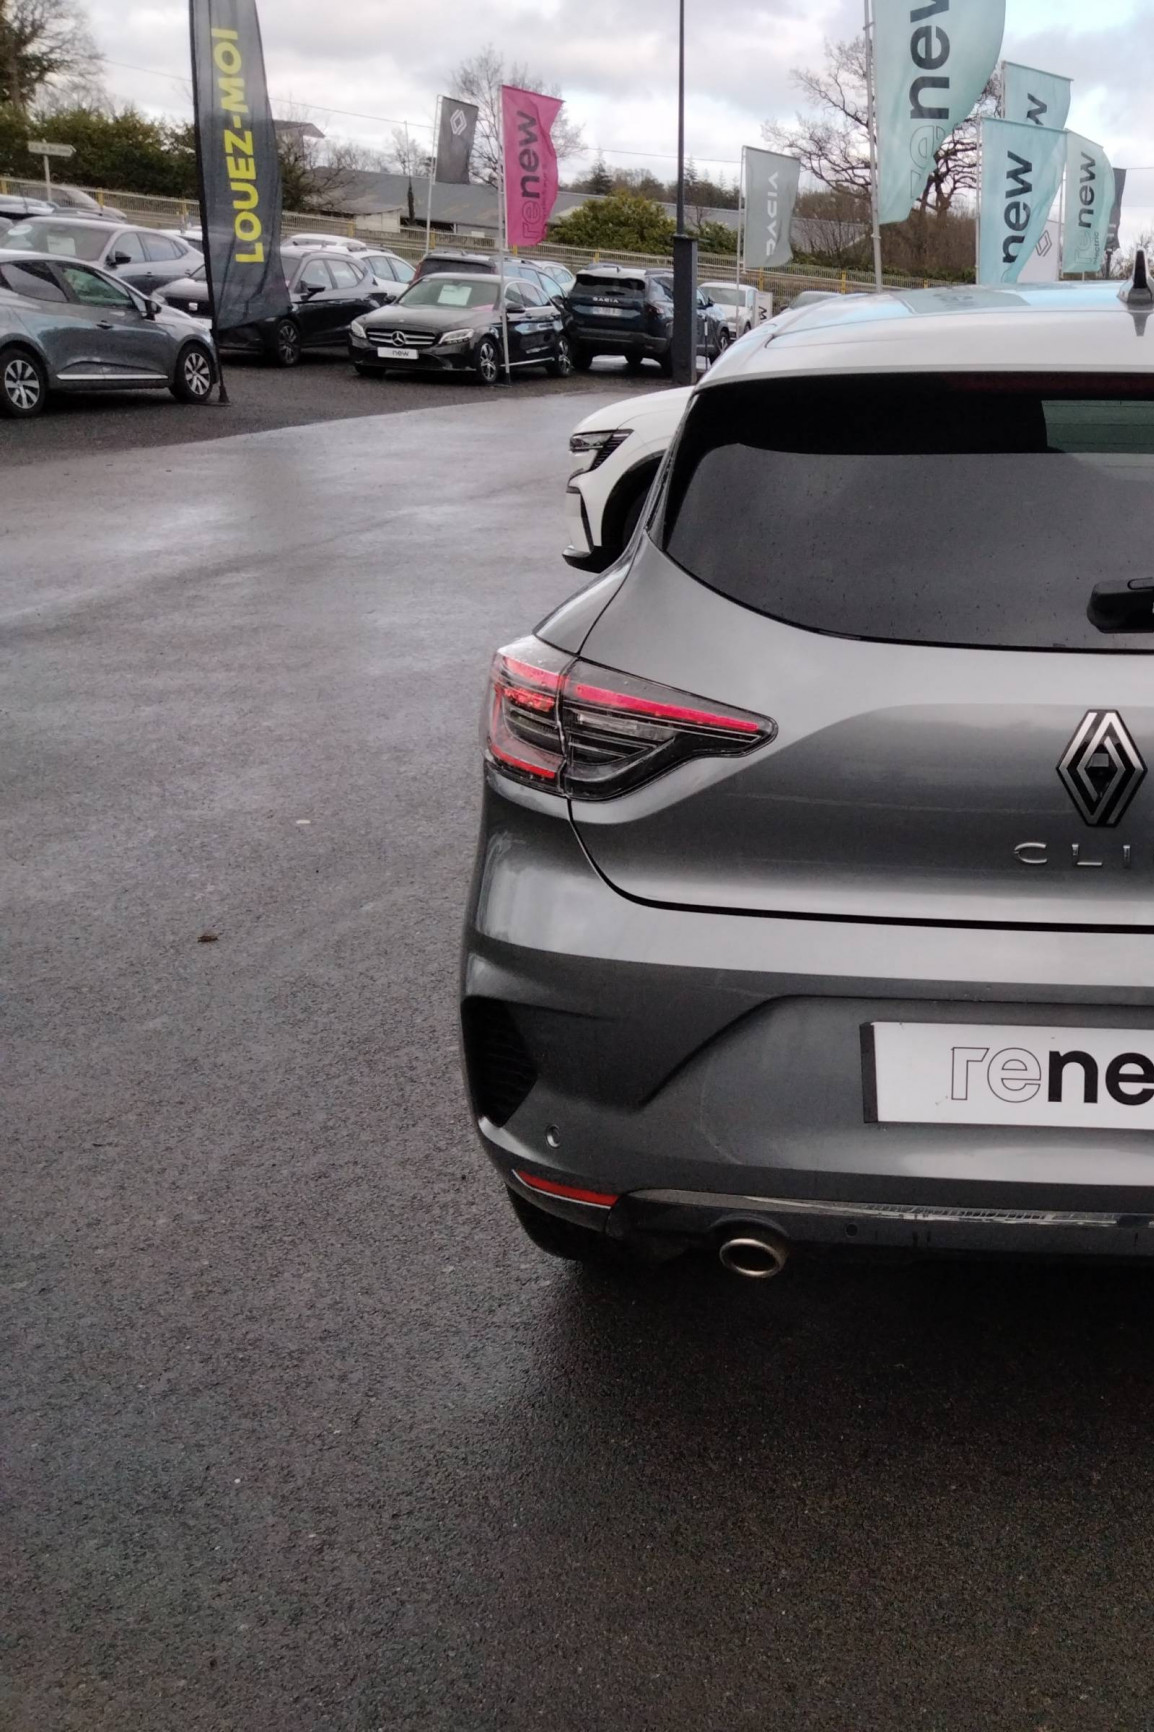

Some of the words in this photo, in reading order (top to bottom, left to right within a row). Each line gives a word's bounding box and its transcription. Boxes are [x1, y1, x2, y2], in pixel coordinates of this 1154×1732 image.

[211, 28, 264, 263] LOUEZ-MOI
[909, 0, 950, 199] ene
[517, 110, 540, 239] renew
[1002, 151, 1033, 266] new
[1074, 151, 1096, 265] renew
